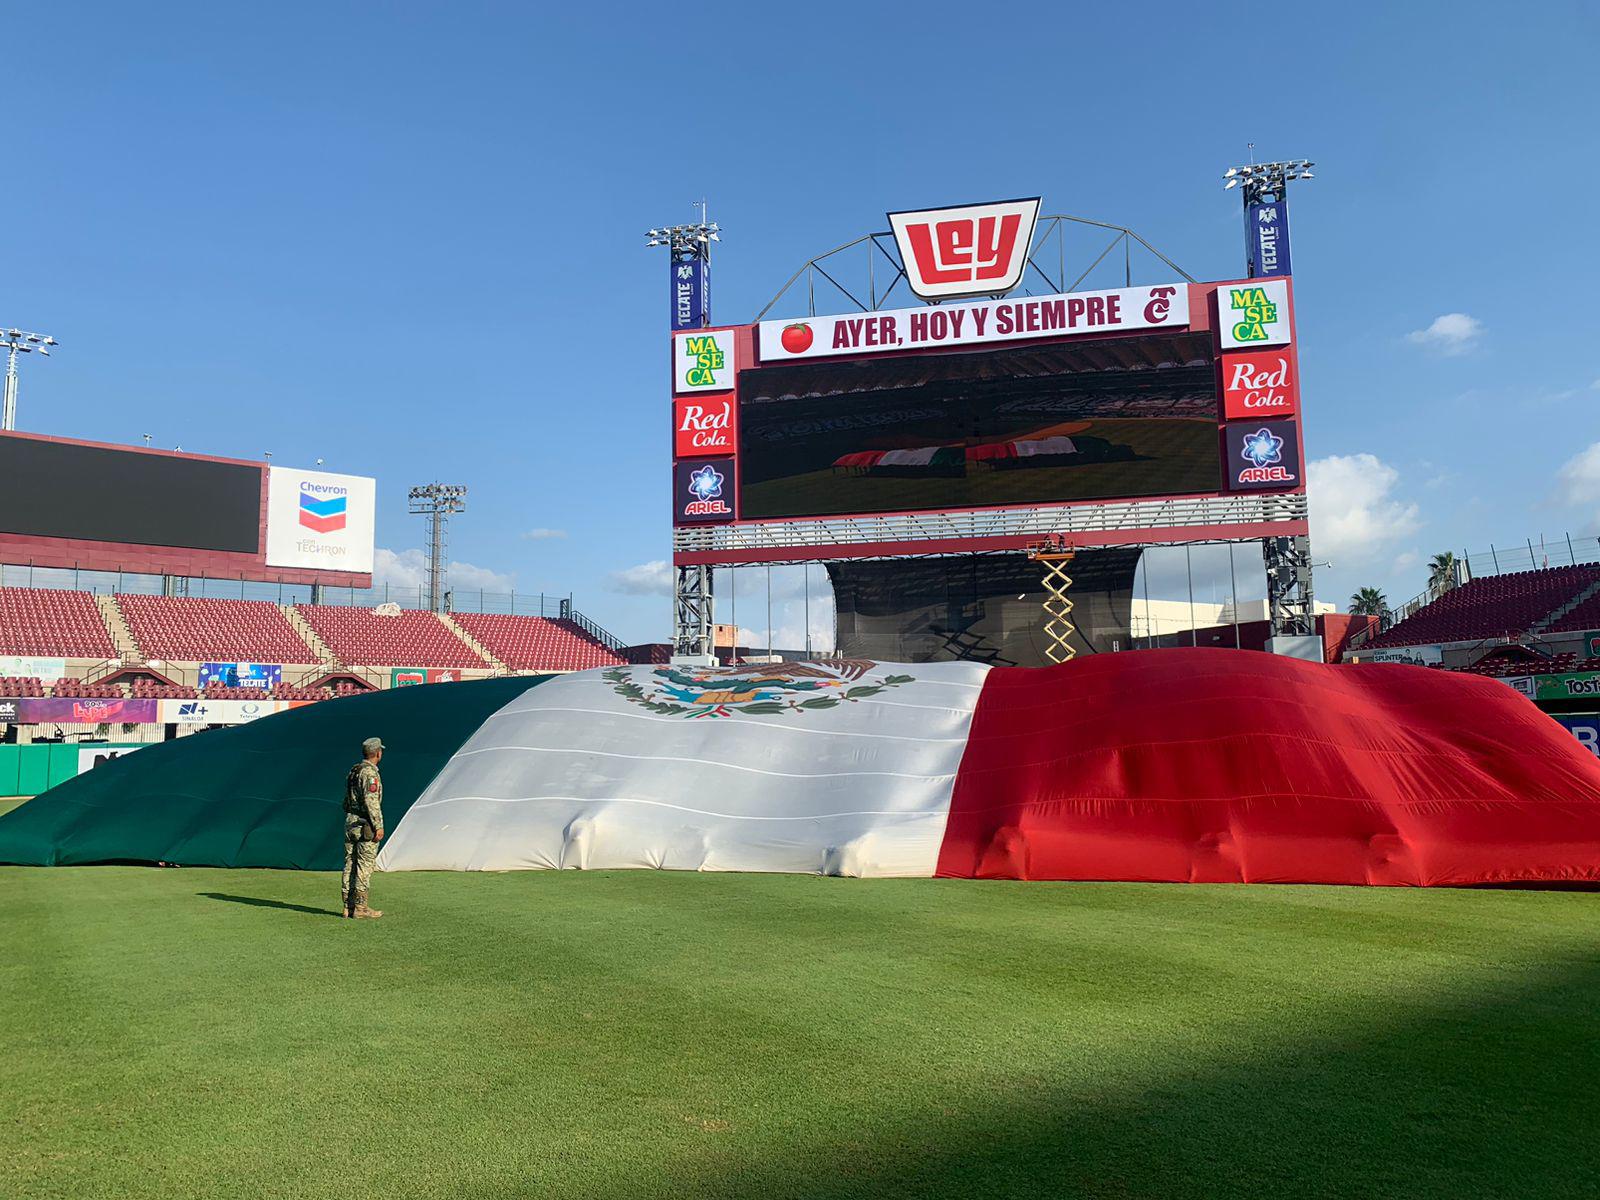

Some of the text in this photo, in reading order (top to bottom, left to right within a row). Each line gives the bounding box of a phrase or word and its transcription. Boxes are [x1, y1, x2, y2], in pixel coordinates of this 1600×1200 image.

[905, 214, 1022, 285] Ley
[1259, 226, 1278, 274] TECATE
[677, 283, 691, 326] TECATE
[832, 295, 1122, 349] AYER, HOY Y SIEMPRE
[1227, 358, 1291, 391] Red
[1243, 389, 1286, 408] Cola
[679, 402, 732, 431] Red
[692, 430, 728, 447] Cola
[1239, 466, 1294, 483] ARIEL
[300, 481, 347, 495] Chevron
[685, 500, 731, 515] ARIEL
[296, 541, 346, 556] TECHRON
[239, 679, 267, 688] TECATE
[1565, 676, 1600, 695] TOST
